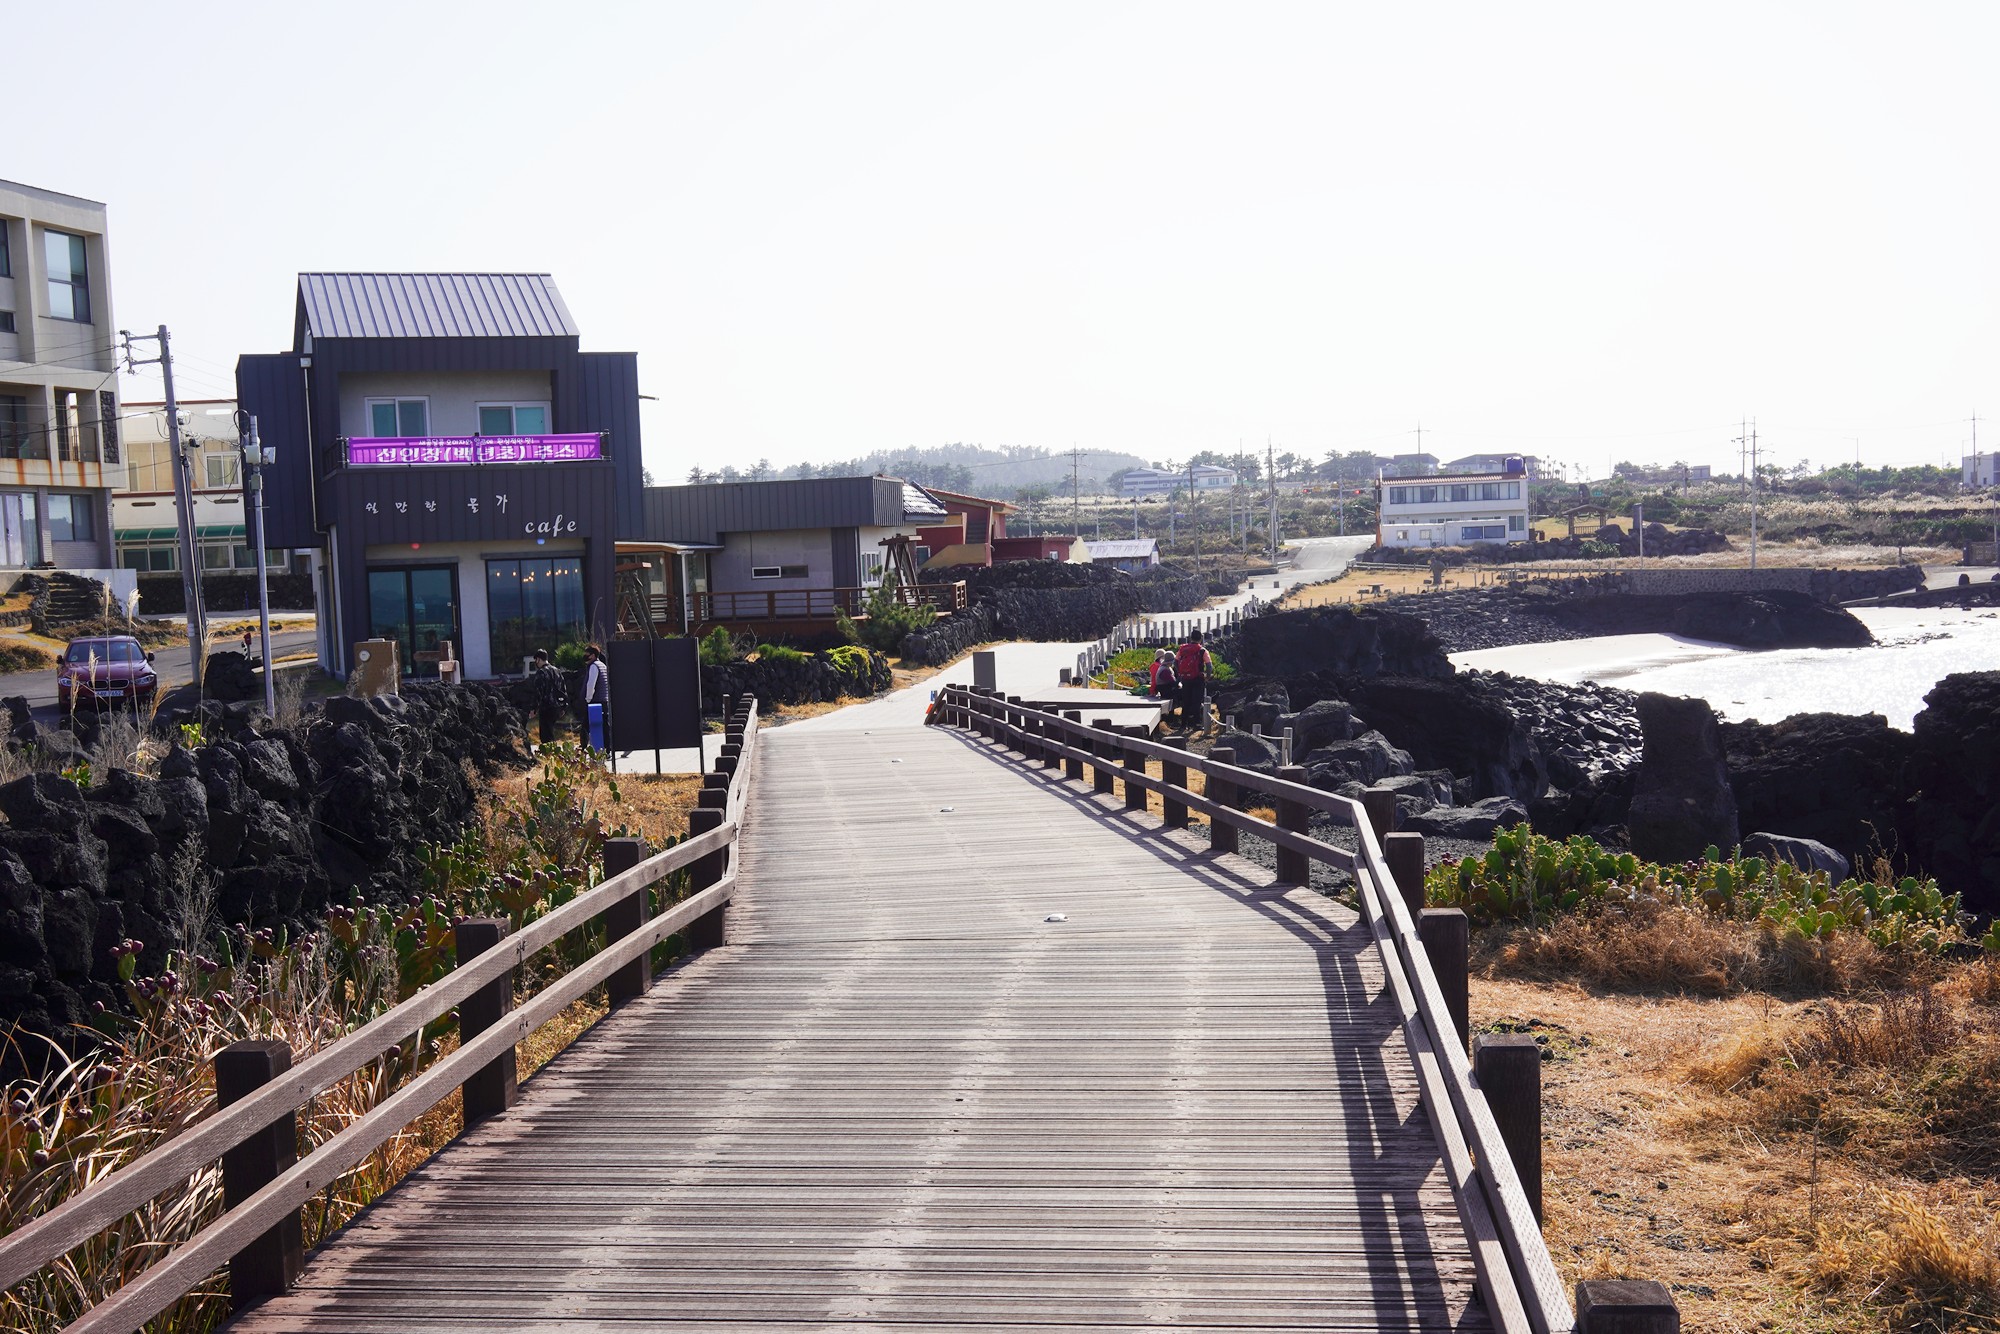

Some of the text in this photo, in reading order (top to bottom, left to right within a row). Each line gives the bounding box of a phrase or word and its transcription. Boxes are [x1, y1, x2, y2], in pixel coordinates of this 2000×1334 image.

[496, 437, 523, 446] 환상적인
[376, 444, 576, 463] 선인장(백년초) 주스
[365, 494, 508, 515] 쉴만한 물가
[524, 514, 577, 537] cafe
